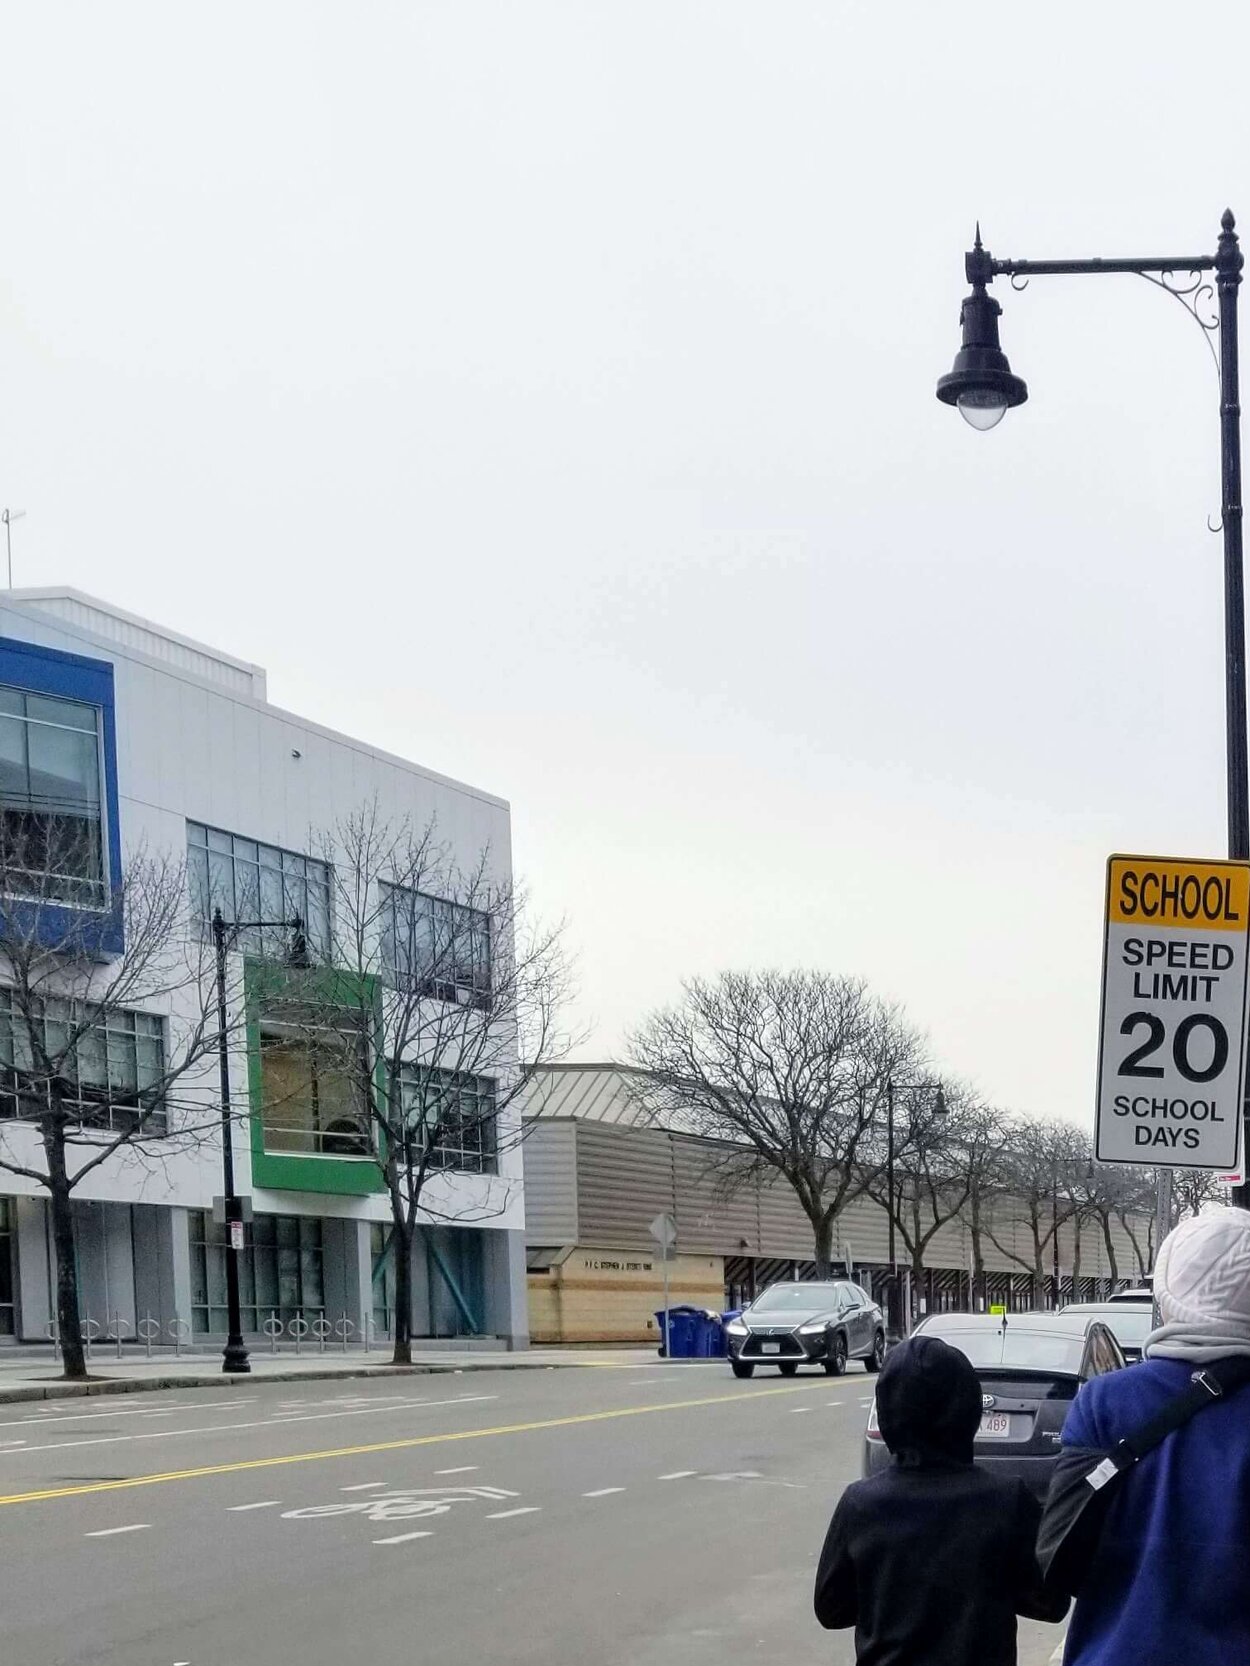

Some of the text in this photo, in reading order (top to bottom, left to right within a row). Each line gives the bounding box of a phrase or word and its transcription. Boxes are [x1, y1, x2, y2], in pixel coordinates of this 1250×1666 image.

[1120, 871, 1239, 920] SCHOOL
[1122, 938, 1234, 970] SPEED
[1134, 972, 1220, 1002] LIMIT
[1118, 1012, 1229, 1083] 20
[1113, 1096, 1225, 1122] SCHOOL
[1135, 1126, 1200, 1149] DAYS
[987, 1419, 1007, 1431] 489
